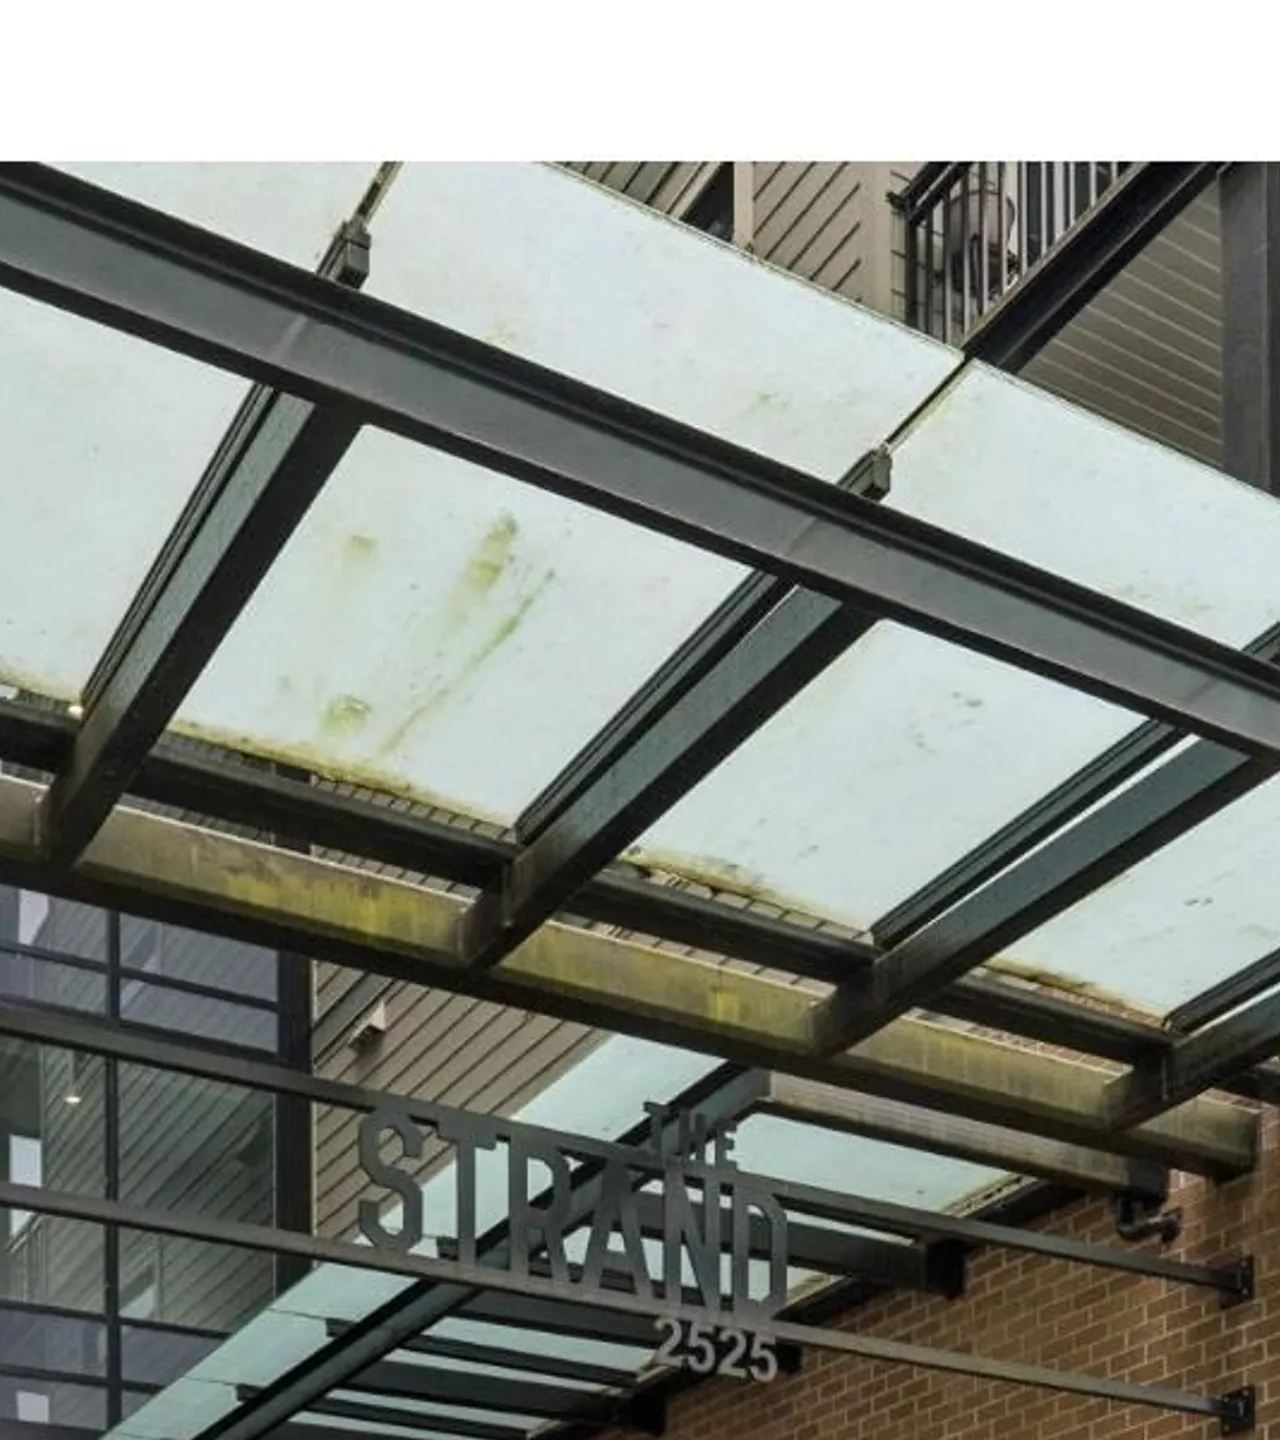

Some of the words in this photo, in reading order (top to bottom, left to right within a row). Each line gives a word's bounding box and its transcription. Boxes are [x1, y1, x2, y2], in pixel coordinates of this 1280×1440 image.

[642, 1101, 739, 1174] THE
[359, 1107, 788, 1317] STRAND
[654, 1317, 780, 1383] 2525
